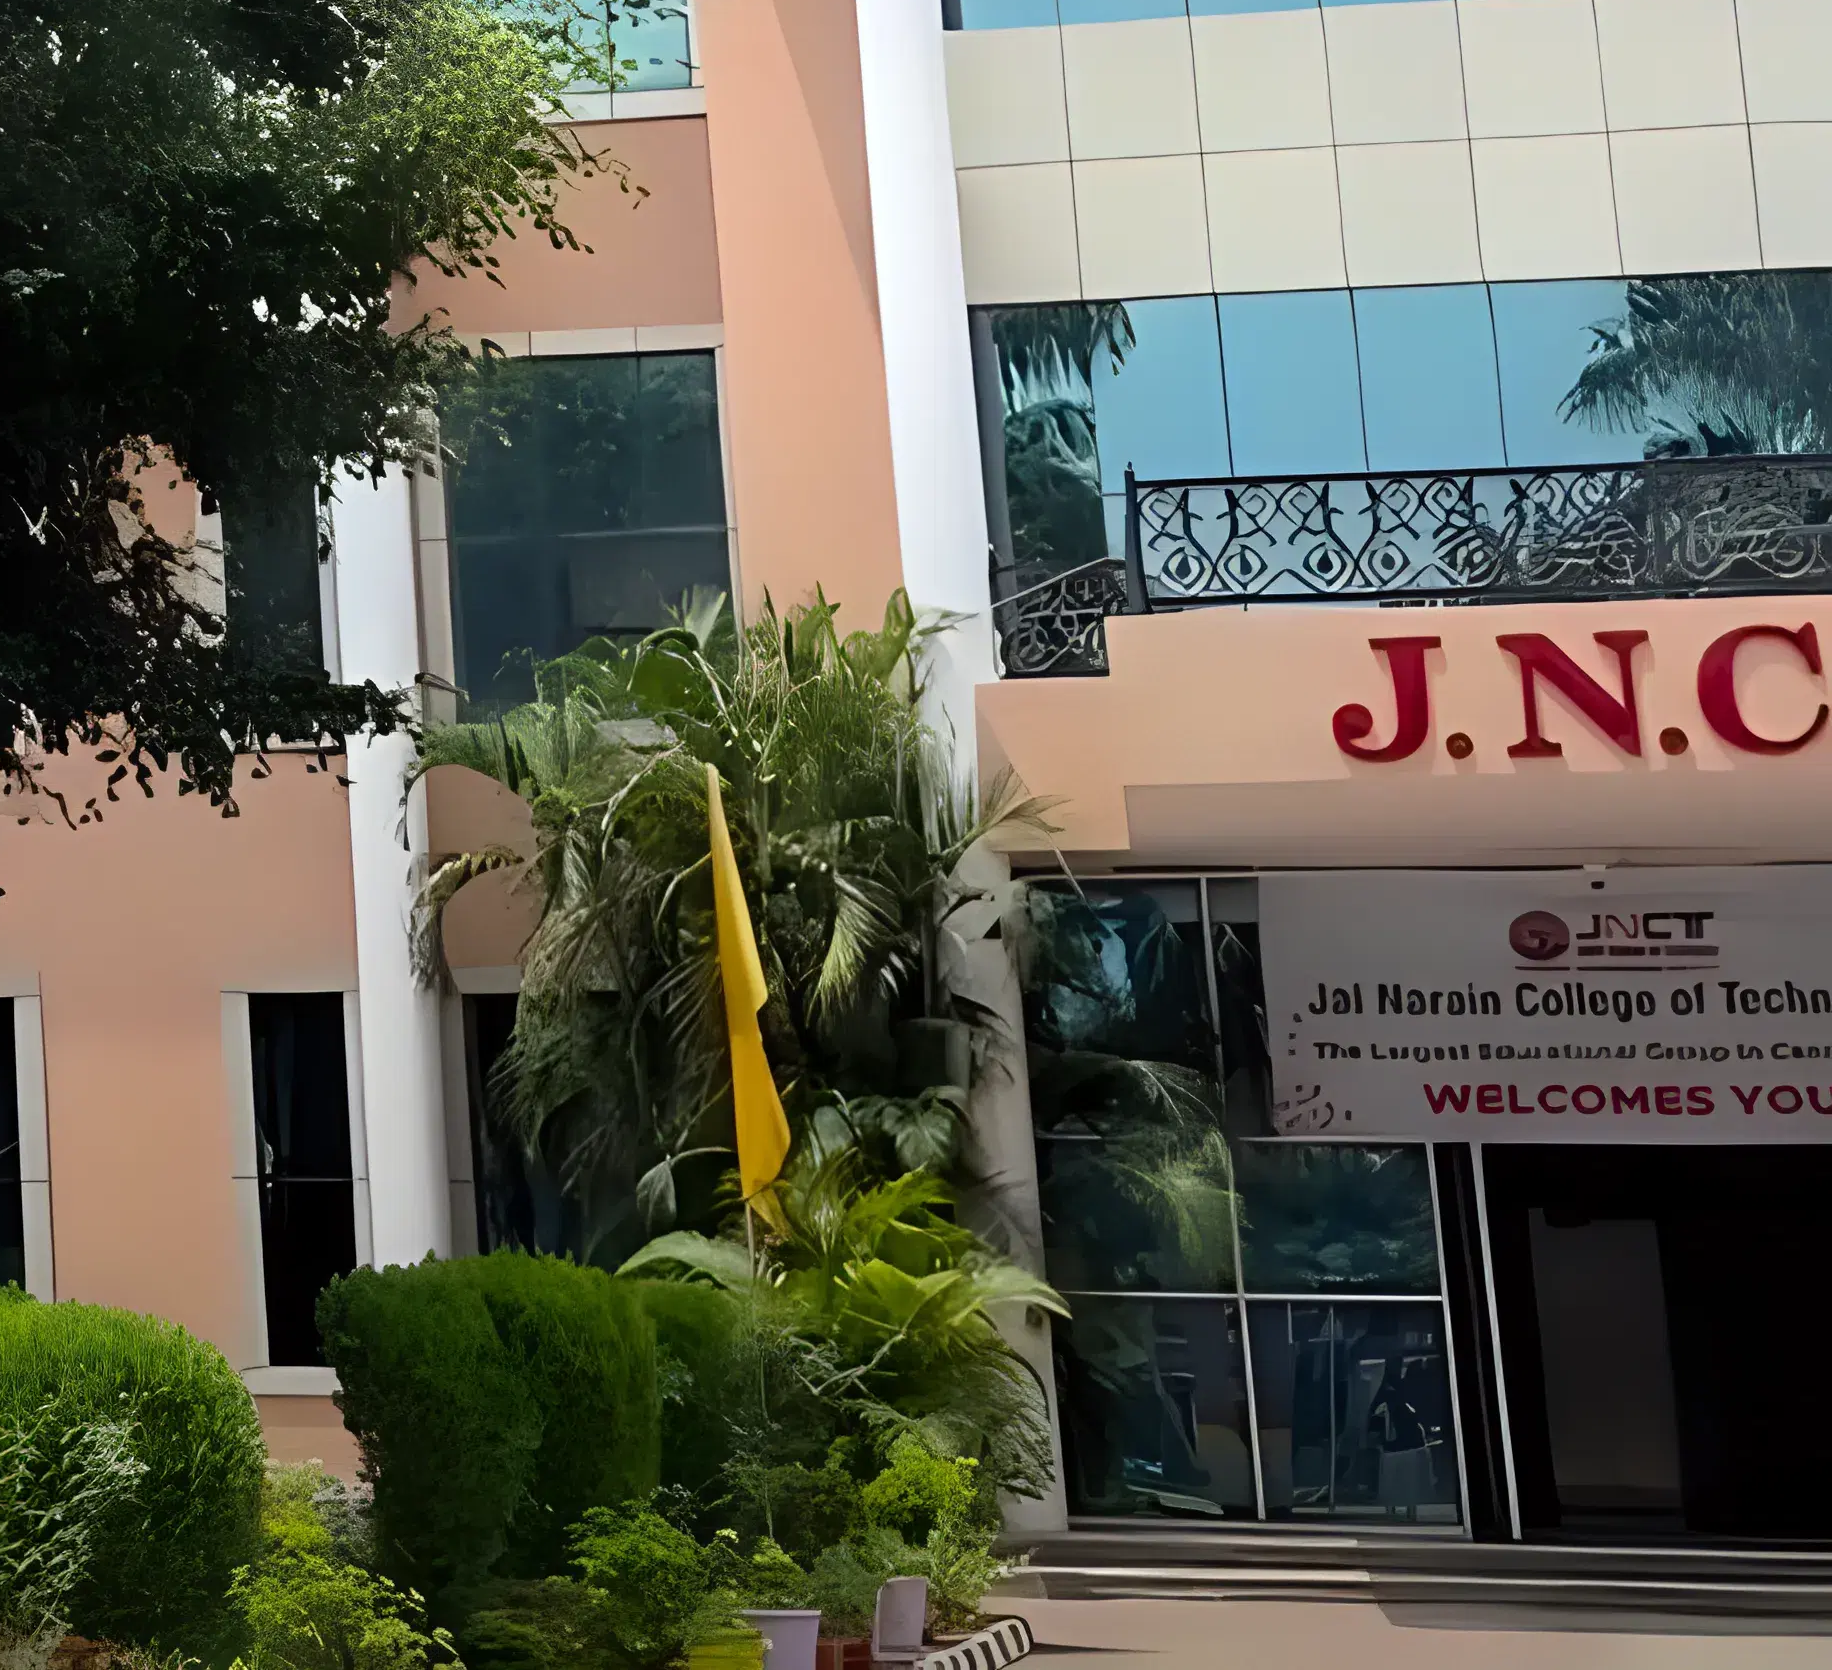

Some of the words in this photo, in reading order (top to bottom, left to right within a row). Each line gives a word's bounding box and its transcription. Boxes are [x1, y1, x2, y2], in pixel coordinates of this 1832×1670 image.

[1575, 911, 1715, 941] JNCT
[1516, 981, 1657, 1023] College
[1423, 1083, 1715, 1116] WELCOMES
[1729, 1084, 1832, 1115] YOU
